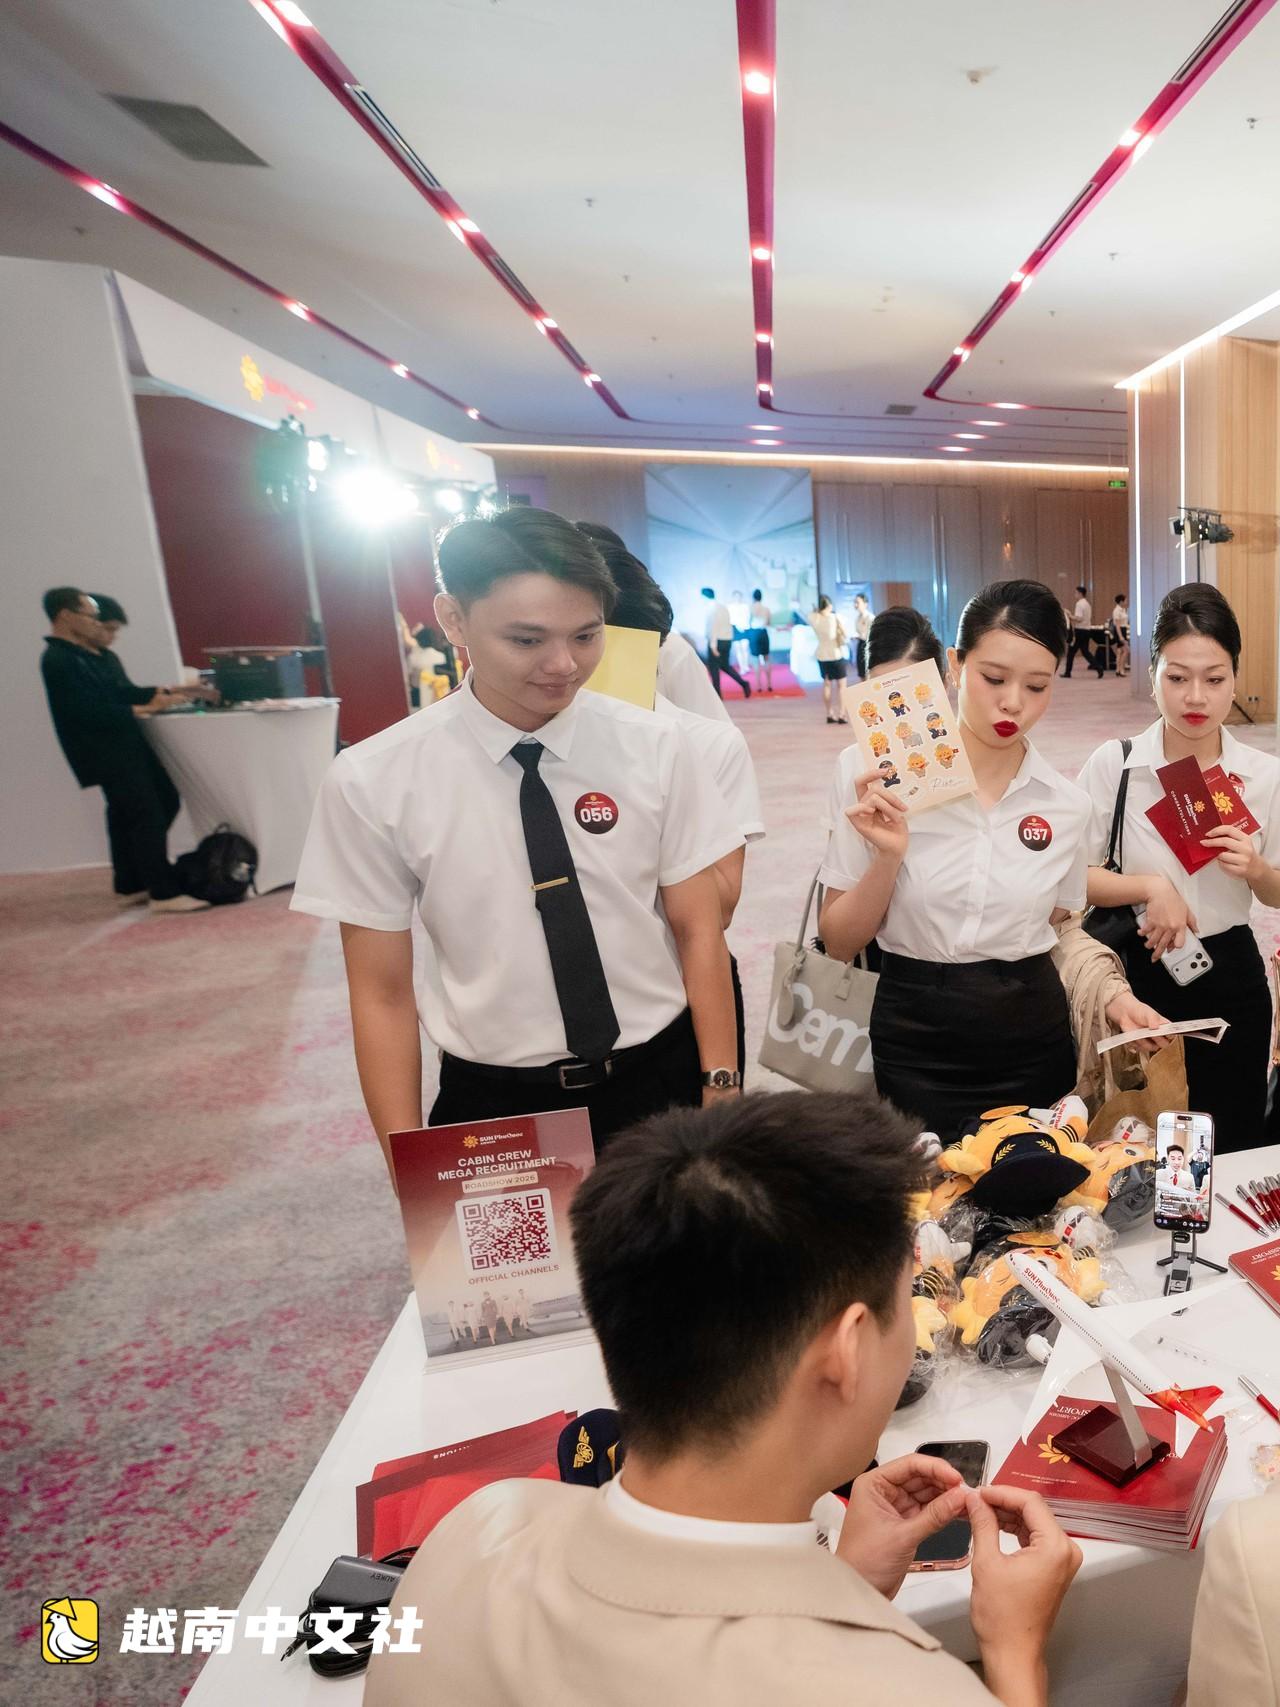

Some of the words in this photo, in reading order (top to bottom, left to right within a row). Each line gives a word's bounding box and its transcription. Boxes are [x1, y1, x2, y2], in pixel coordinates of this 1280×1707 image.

[580, 806, 613, 823] 056
[1023, 828, 1048, 841] 037
[479, 1135, 494, 1143] SUN
[457, 1153, 495, 1167] CABIN
[497, 1149, 532, 1162] CREW
[438, 1168, 474, 1181] MEGA
[475, 1156, 557, 1176] RECRUITMENT
[464, 1178, 513, 1190] ROADSHOW
[514, 1174, 536, 1184] 2026
[468, 1273, 509, 1286] OFFICIAL
[510, 1264, 560, 1278] CHANNELS
[1024, 1267, 1037, 1281] SUN
[1058, 1406, 1092, 1416] SPORT
